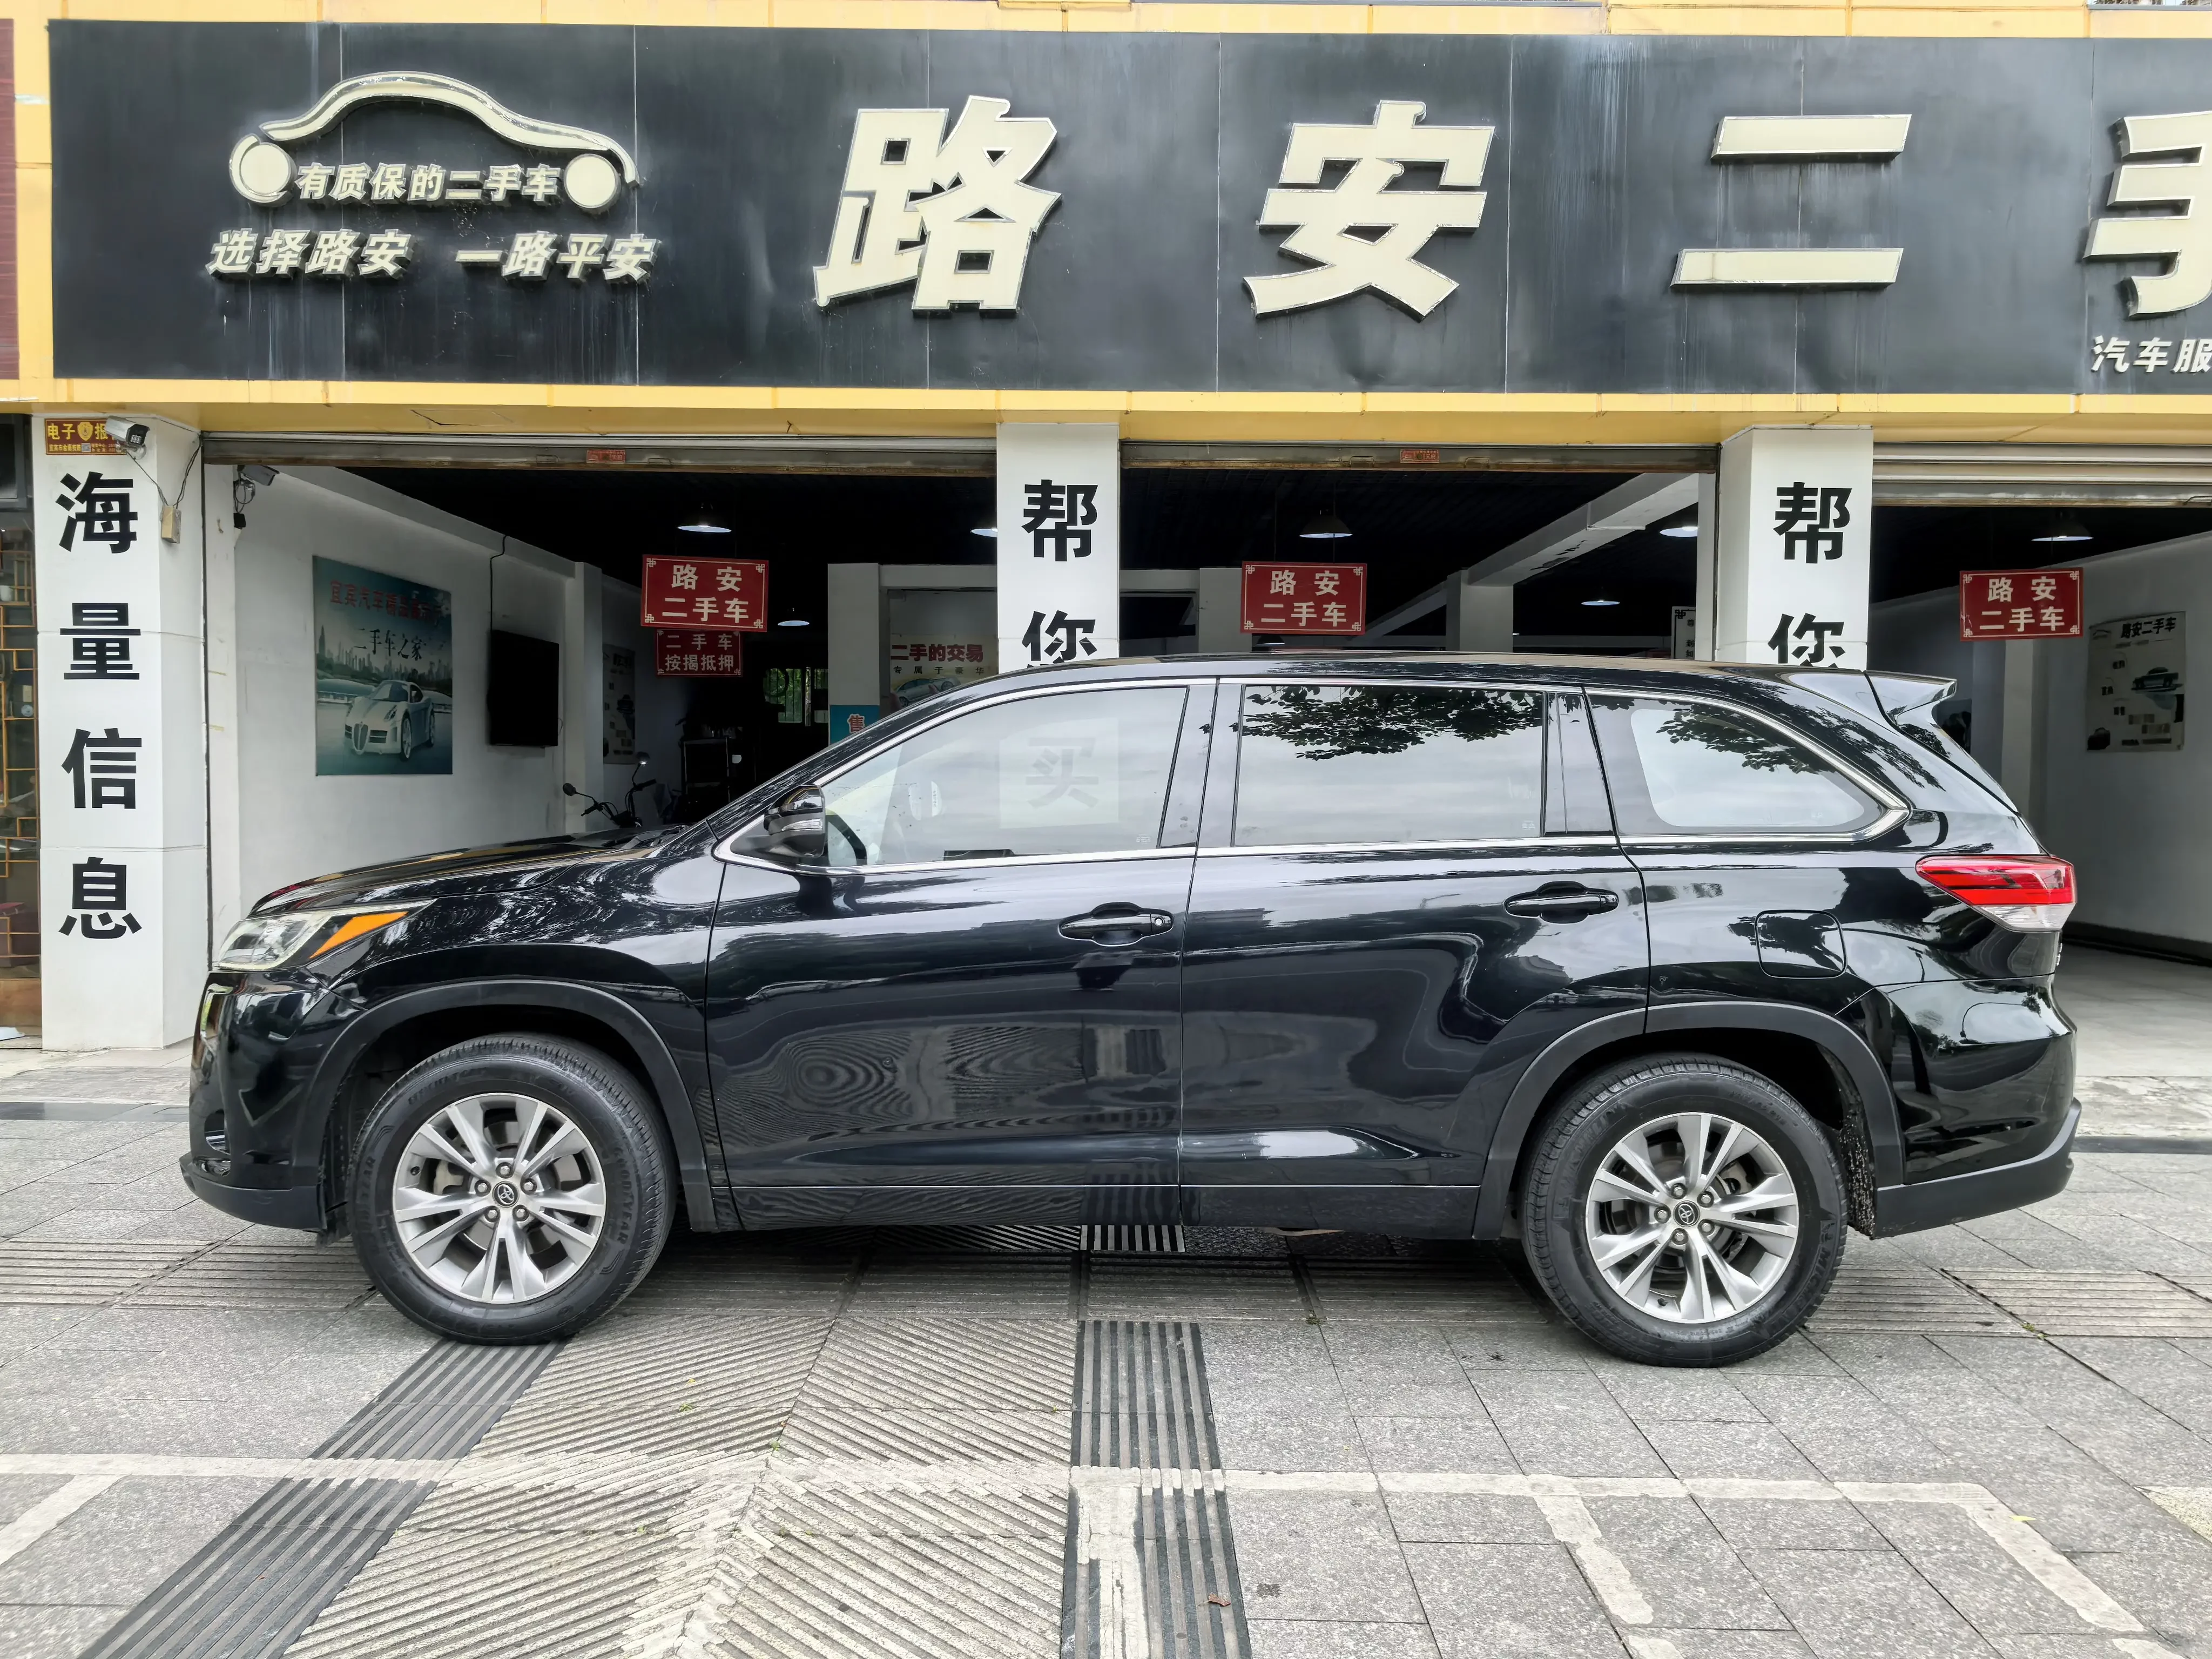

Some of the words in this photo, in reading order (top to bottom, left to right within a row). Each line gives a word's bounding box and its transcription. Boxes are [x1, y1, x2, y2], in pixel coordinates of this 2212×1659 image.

[295, 162, 564, 204] 有质保的二手车
[206, 228, 417, 280] 选择路安
[455, 231, 663, 282] 一路平安
[2091, 335, 2212, 374] 汽车服
[671, 564, 743, 592] 路安
[1270, 570, 1340, 596] 路安
[1987, 576, 2057, 603] 路安
[662, 597, 749, 623] 二手车
[1260, 602, 1347, 627] 二手车
[1979, 606, 2065, 632] 二手车
[666, 633, 733, 650] 二手车
[891, 643, 984, 663] 二手的交易
[665, 653, 734, 672] 按揭抵押
[56, 471, 142, 939] 海量信息
[1026, 737, 1098, 808] 买
